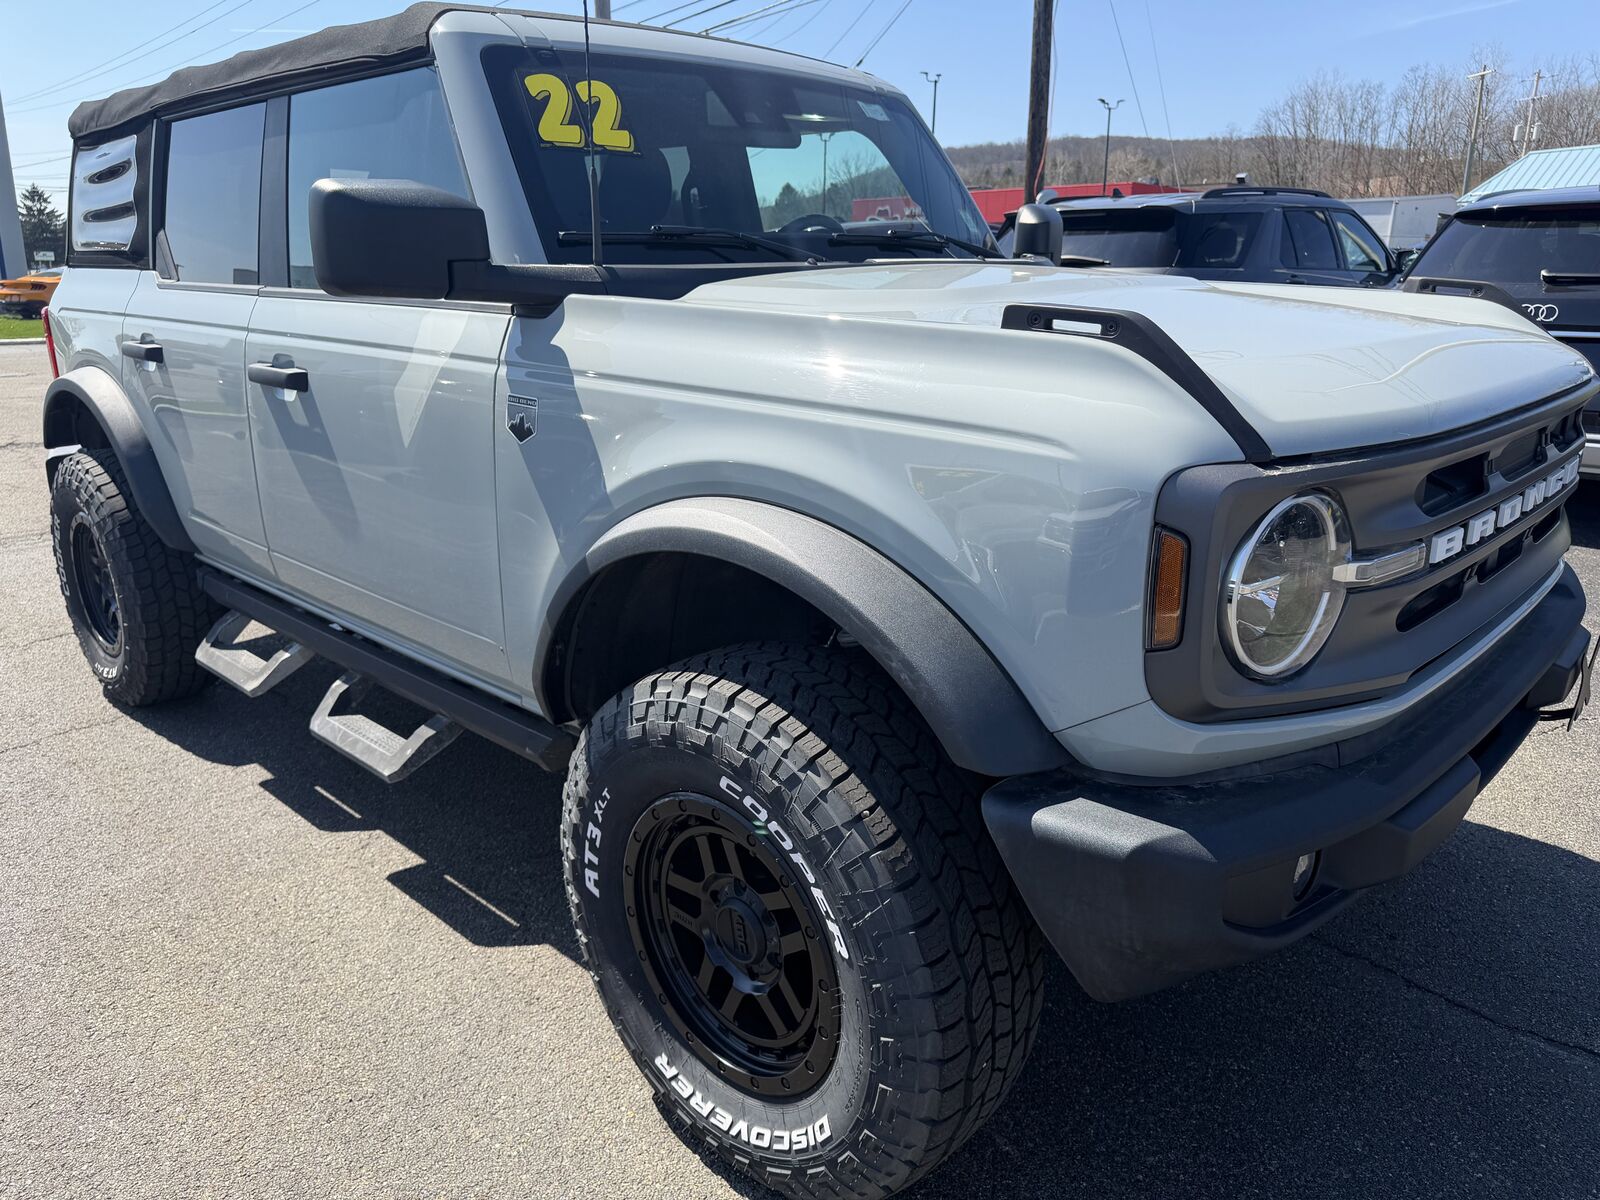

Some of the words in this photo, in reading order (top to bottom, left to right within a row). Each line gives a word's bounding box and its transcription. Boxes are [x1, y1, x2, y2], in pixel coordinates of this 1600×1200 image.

[524, 73, 635, 152] 22
[53, 513, 70, 597] COOPER
[1429, 456, 1580, 564] BRONCO
[584, 820, 602, 899] AT3
[593, 787, 611, 824] XLT
[719, 775, 849, 960] COOPER
[654, 1052, 832, 1151] DISCOVERER
